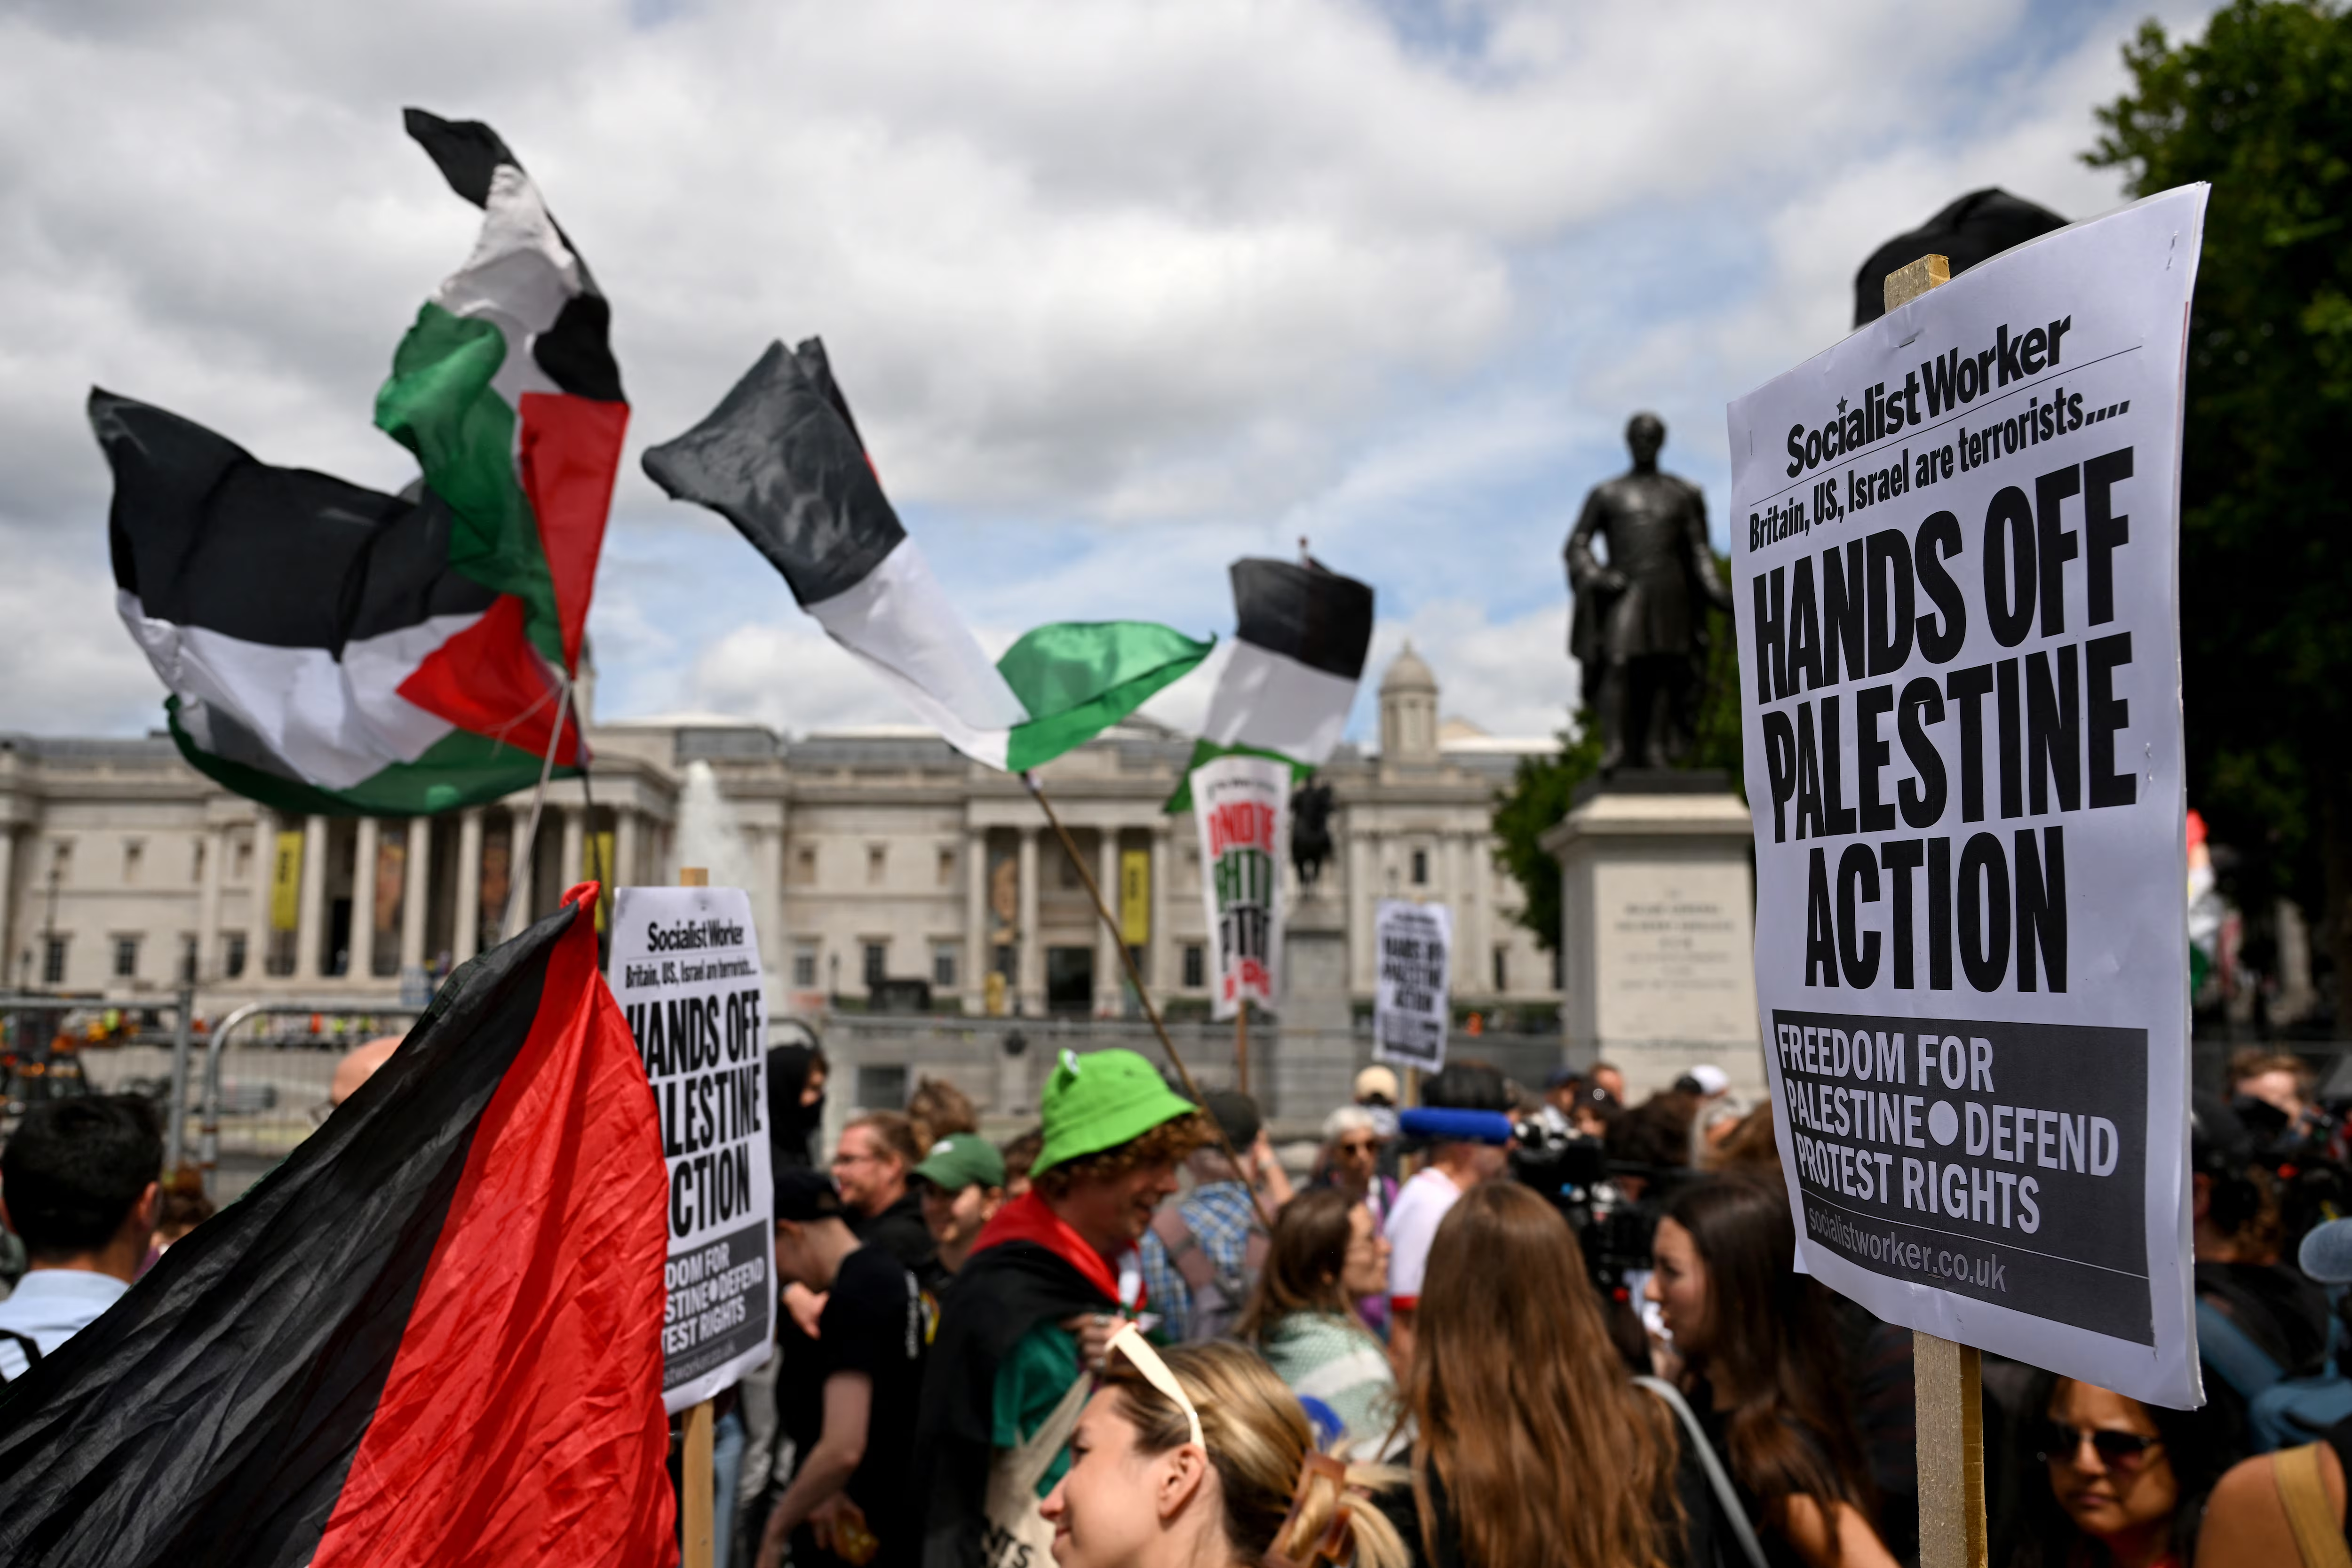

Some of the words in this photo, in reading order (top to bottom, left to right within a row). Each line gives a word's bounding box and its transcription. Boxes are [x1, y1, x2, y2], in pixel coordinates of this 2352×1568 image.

[1750, 498, 1810, 552] Britain,
[1813, 478, 1844, 523] US,
[1849, 449, 1909, 511] Israel
[1916, 445, 1953, 488] are
[1958, 387, 2130, 470] terrorists....
[1753, 510, 1966, 705] HANDS
[1983, 446, 2134, 647] OFF
[1762, 632, 2137, 843] PALESTINE
[1805, 826, 2067, 993] ACTION
[627, 994, 720, 1079] HANDS
[727, 989, 760, 1063] OFF
[1778, 1024, 1905, 1084] FREEDOM
[1918, 1035, 1994, 1093] FOR
[651, 1062, 761, 1158] LESTINE
[1786, 1077, 1925, 1149] PALESTINE
[1965, 1100, 2119, 1177] DEFEND
[667, 1141, 751, 1239] CTION
[1796, 1132, 1892, 1204] PROTEST
[1903, 1155, 2040, 1234] RIGHTS
[1809, 1206, 2007, 1292] socialistworker.co.uk
[664, 1281, 709, 1323] STINE
